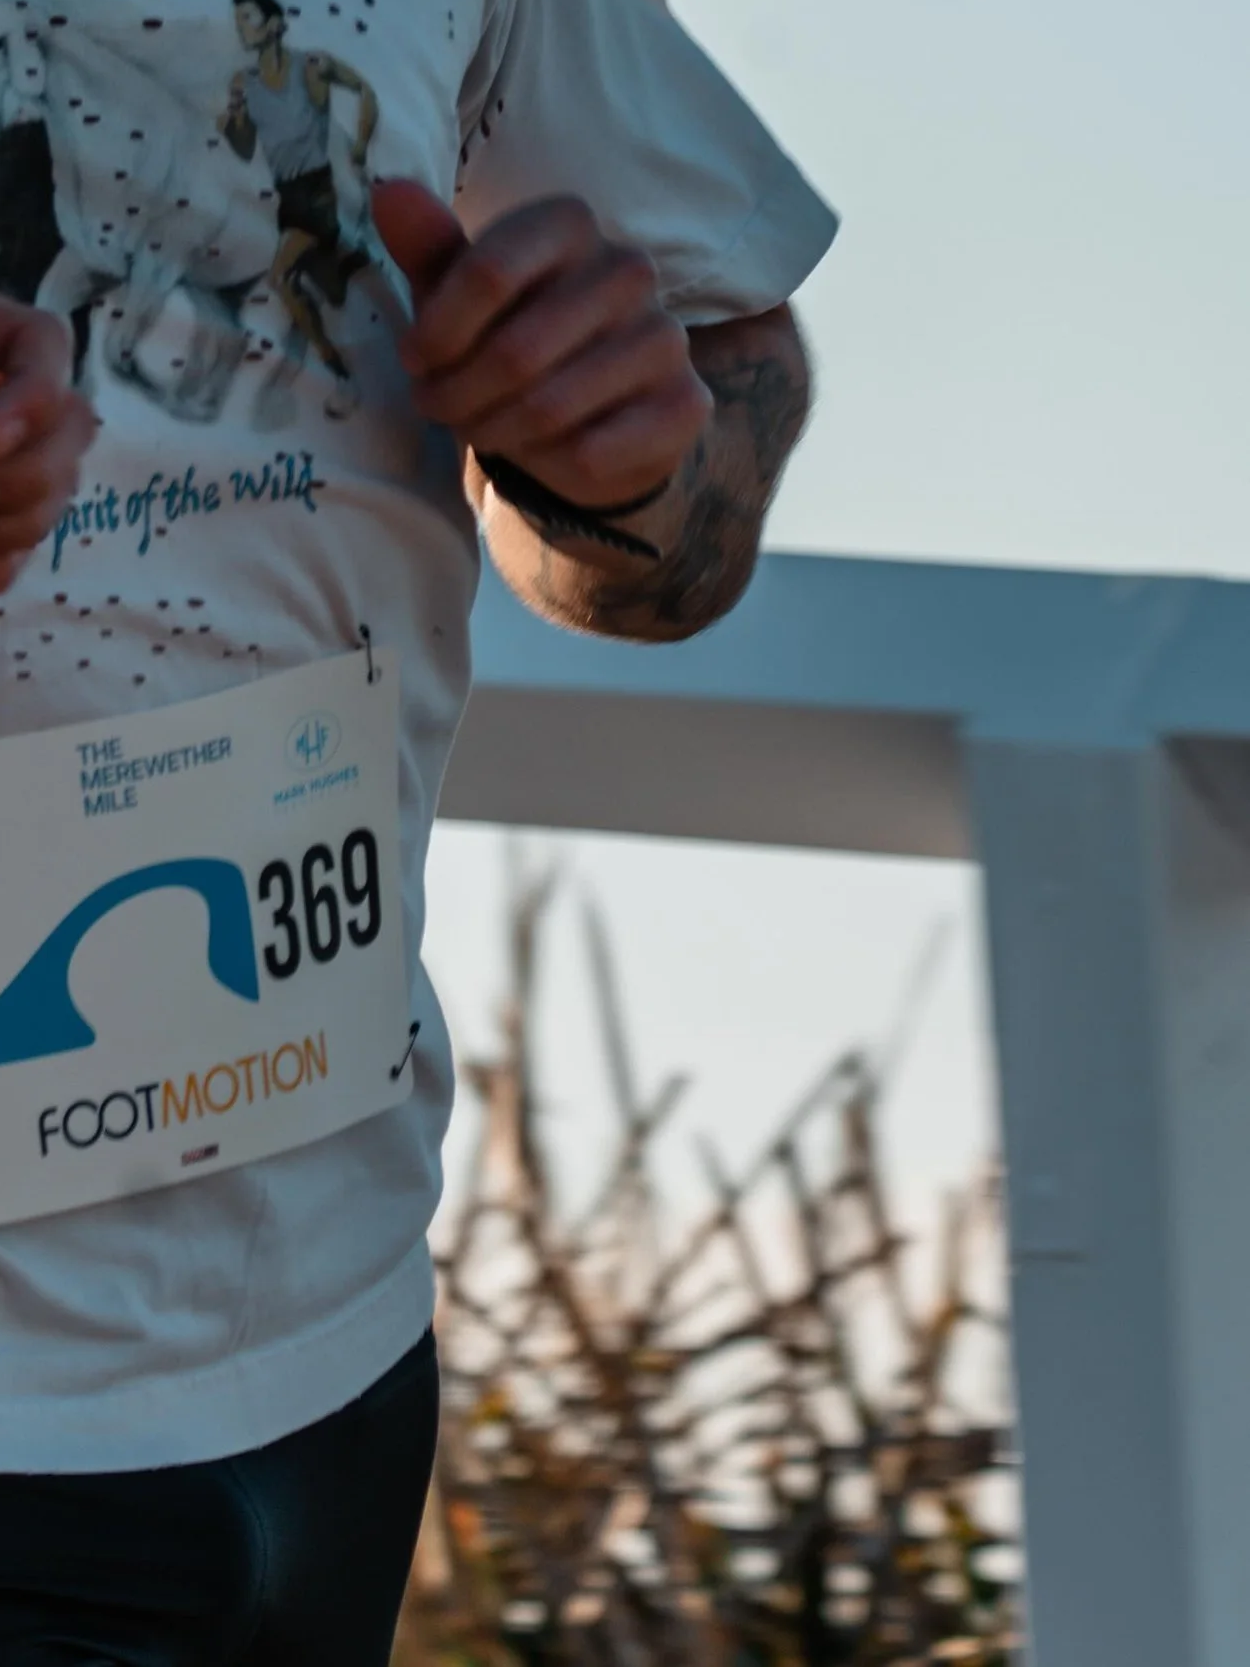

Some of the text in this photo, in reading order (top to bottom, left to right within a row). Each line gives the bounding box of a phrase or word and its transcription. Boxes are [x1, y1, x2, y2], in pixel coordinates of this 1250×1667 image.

[125, 471, 163, 556] of
[164, 463, 222, 522] the
[77, 737, 123, 766] THE
[80, 736, 232, 791] MEREWETHER
[83, 787, 138, 818] MILE
[257, 828, 381, 980] 369
[38, 1029, 328, 1157] FOOTMOTION
